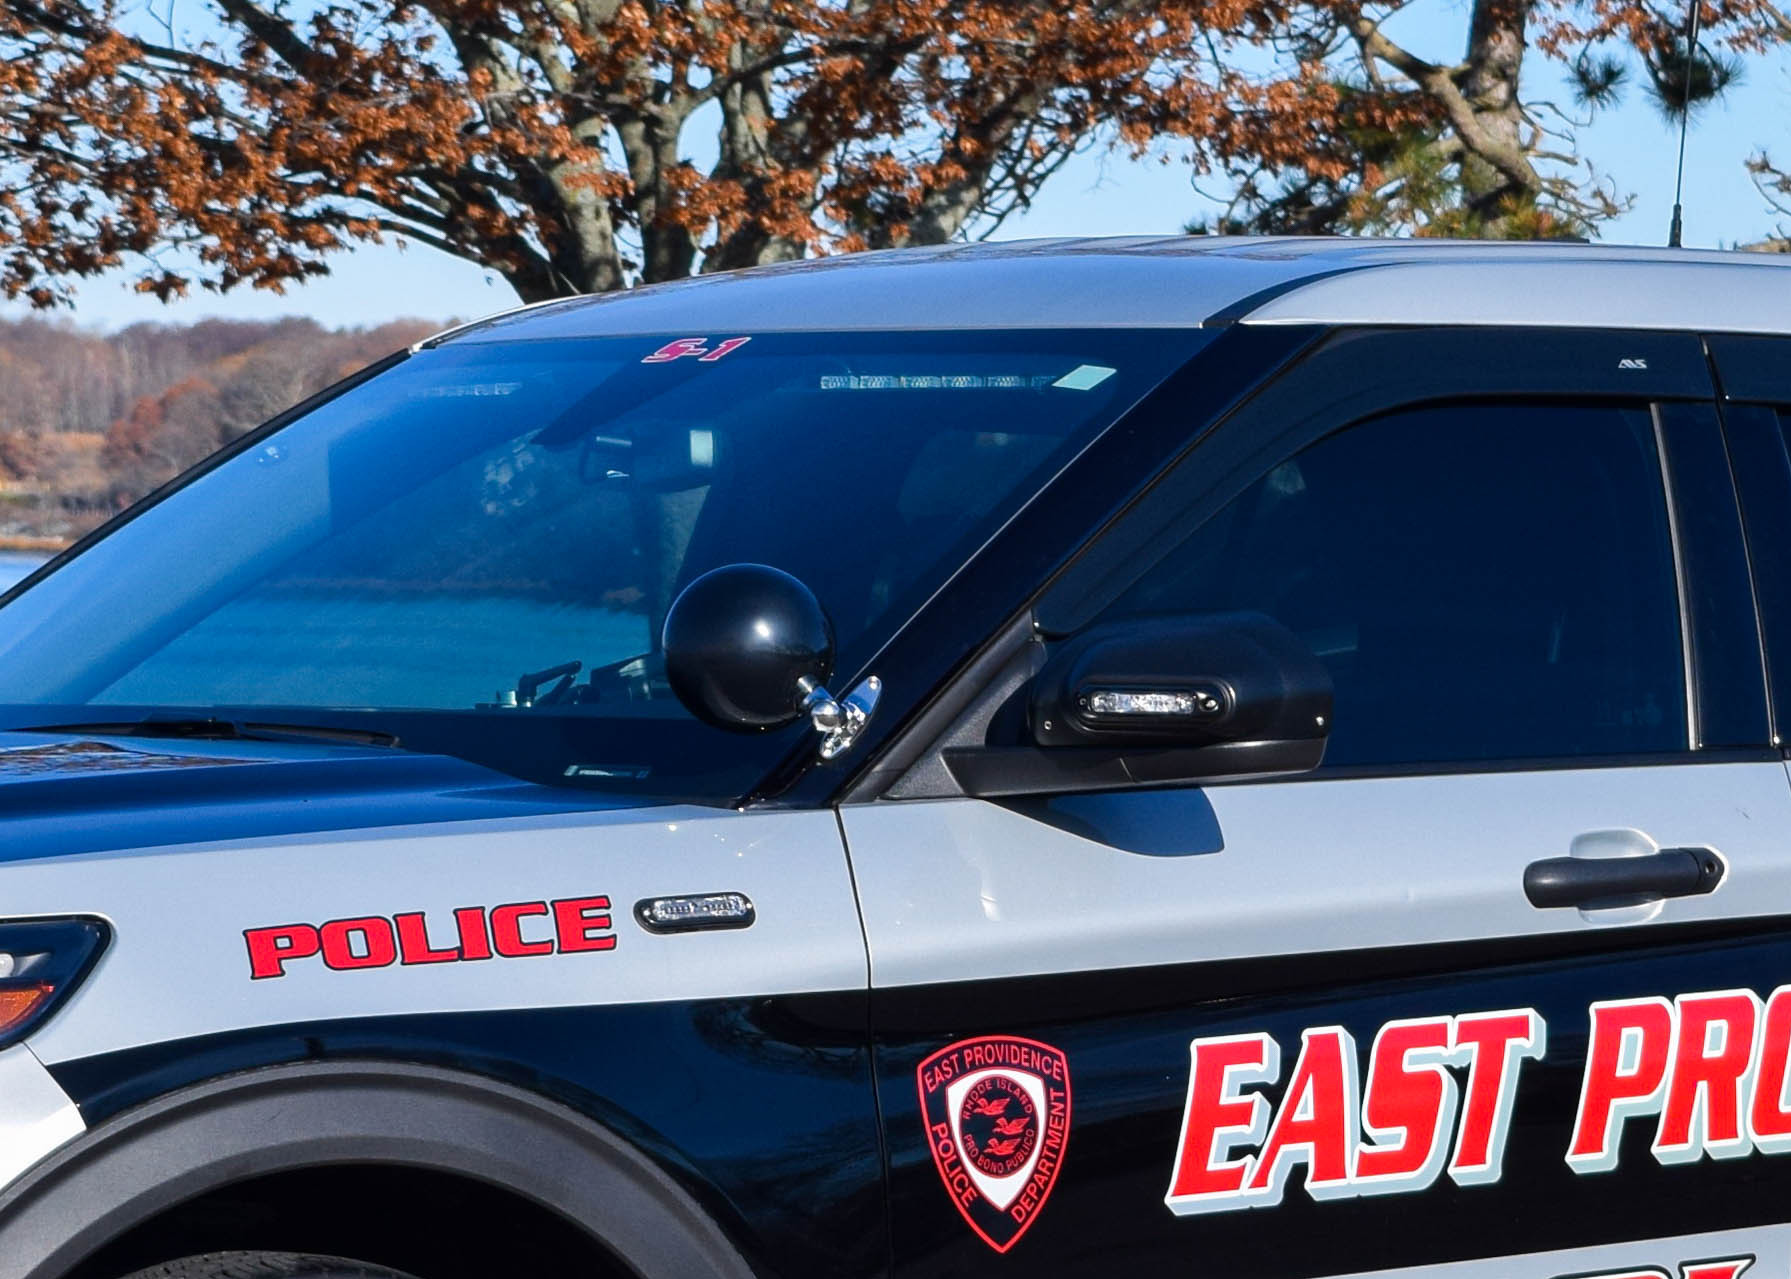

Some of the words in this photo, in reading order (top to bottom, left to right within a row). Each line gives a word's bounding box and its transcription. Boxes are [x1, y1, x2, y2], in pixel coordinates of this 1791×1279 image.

[640, 336, 752, 363] S-1
[242, 894, 618, 981] POLICE
[923, 1053, 959, 1094] EAST
[963, 1042, 1065, 1081] PROVIDENCE
[996, 1077, 1034, 1115] ISLAND
[1010, 1086, 1066, 1225] DEPARTMENT
[1164, 1008, 1547, 1217] EAST
[931, 1121, 979, 1209] POLICE
